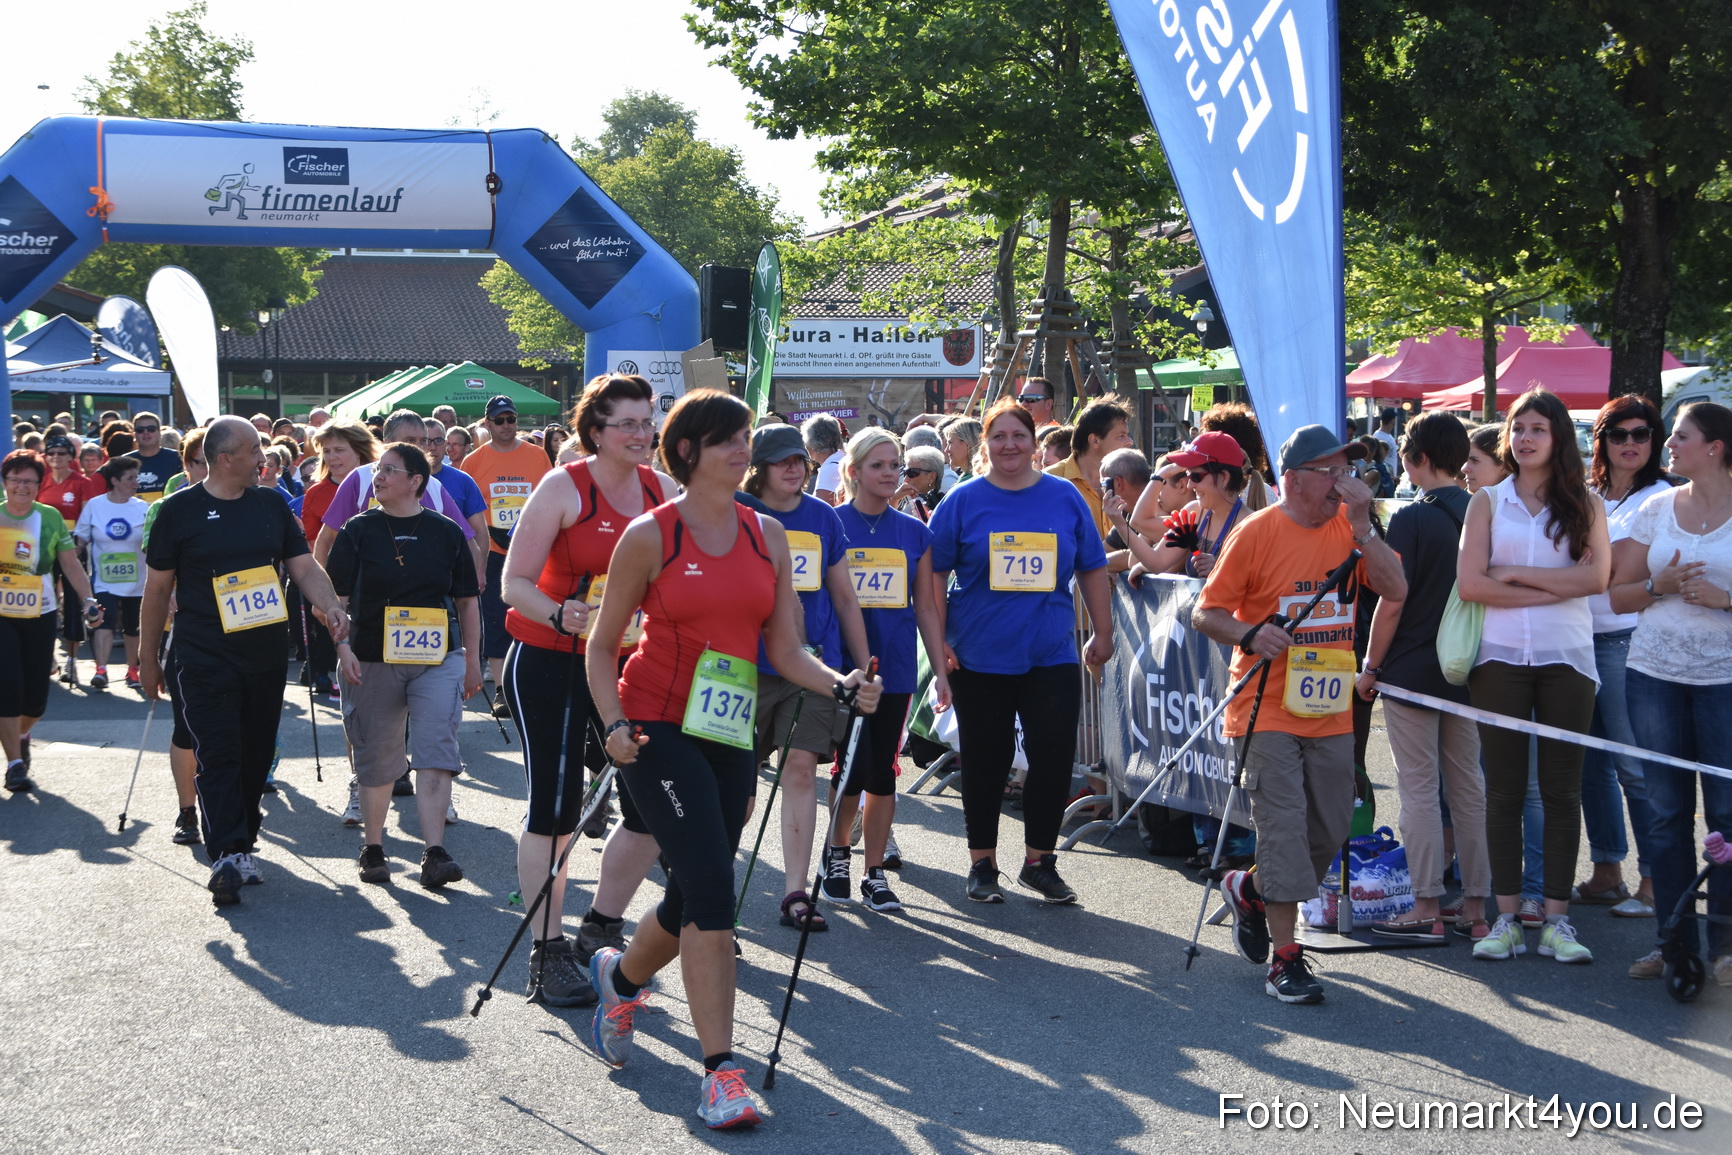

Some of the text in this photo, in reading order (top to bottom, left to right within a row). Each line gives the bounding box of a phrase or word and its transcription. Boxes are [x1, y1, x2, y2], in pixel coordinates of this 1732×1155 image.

[298, 161, 345, 173] Fischer
[262, 185, 404, 213] firmenlauf
[260, 212, 320, 222] neumarkt
[550, 239, 570, 250] und
[572, 237, 591, 248] das
[606, 248, 629, 258] mit!
[777, 326, 831, 343] Jura
[875, 352, 894, 361] grüßt
[911, 351, 932, 359] Gäste
[855, 361, 901, 369] angenehmen
[902, 360, 941, 368] Aufenthalt!
[9, 374, 130, 386] ww.fischer-automobile.de
[786, 388, 843, 401] Willkommen
[799, 398, 847, 409] in meinem
[493, 485, 528, 495] OBI
[104, 564, 135, 576] 1483
[1003, 555, 1043, 575] 719
[854, 572, 894, 591] 747
[1294, 580, 1312, 593] 30
[0, 591, 37, 606] 1000
[225, 587, 279, 615] 1184
[1287, 600, 1349, 621] OBI
[391, 629, 442, 649] 1243
[1293, 626, 1354, 645] eumarkt
[1300, 676, 1342, 700] 610
[700, 686, 753, 724] 1374
[1146, 672, 1234, 746] Fische
[1385, 884, 1412, 897] LIGHT
[1352, 899, 1397, 914] COOLER
[1399, 897, 1415, 909] BA
